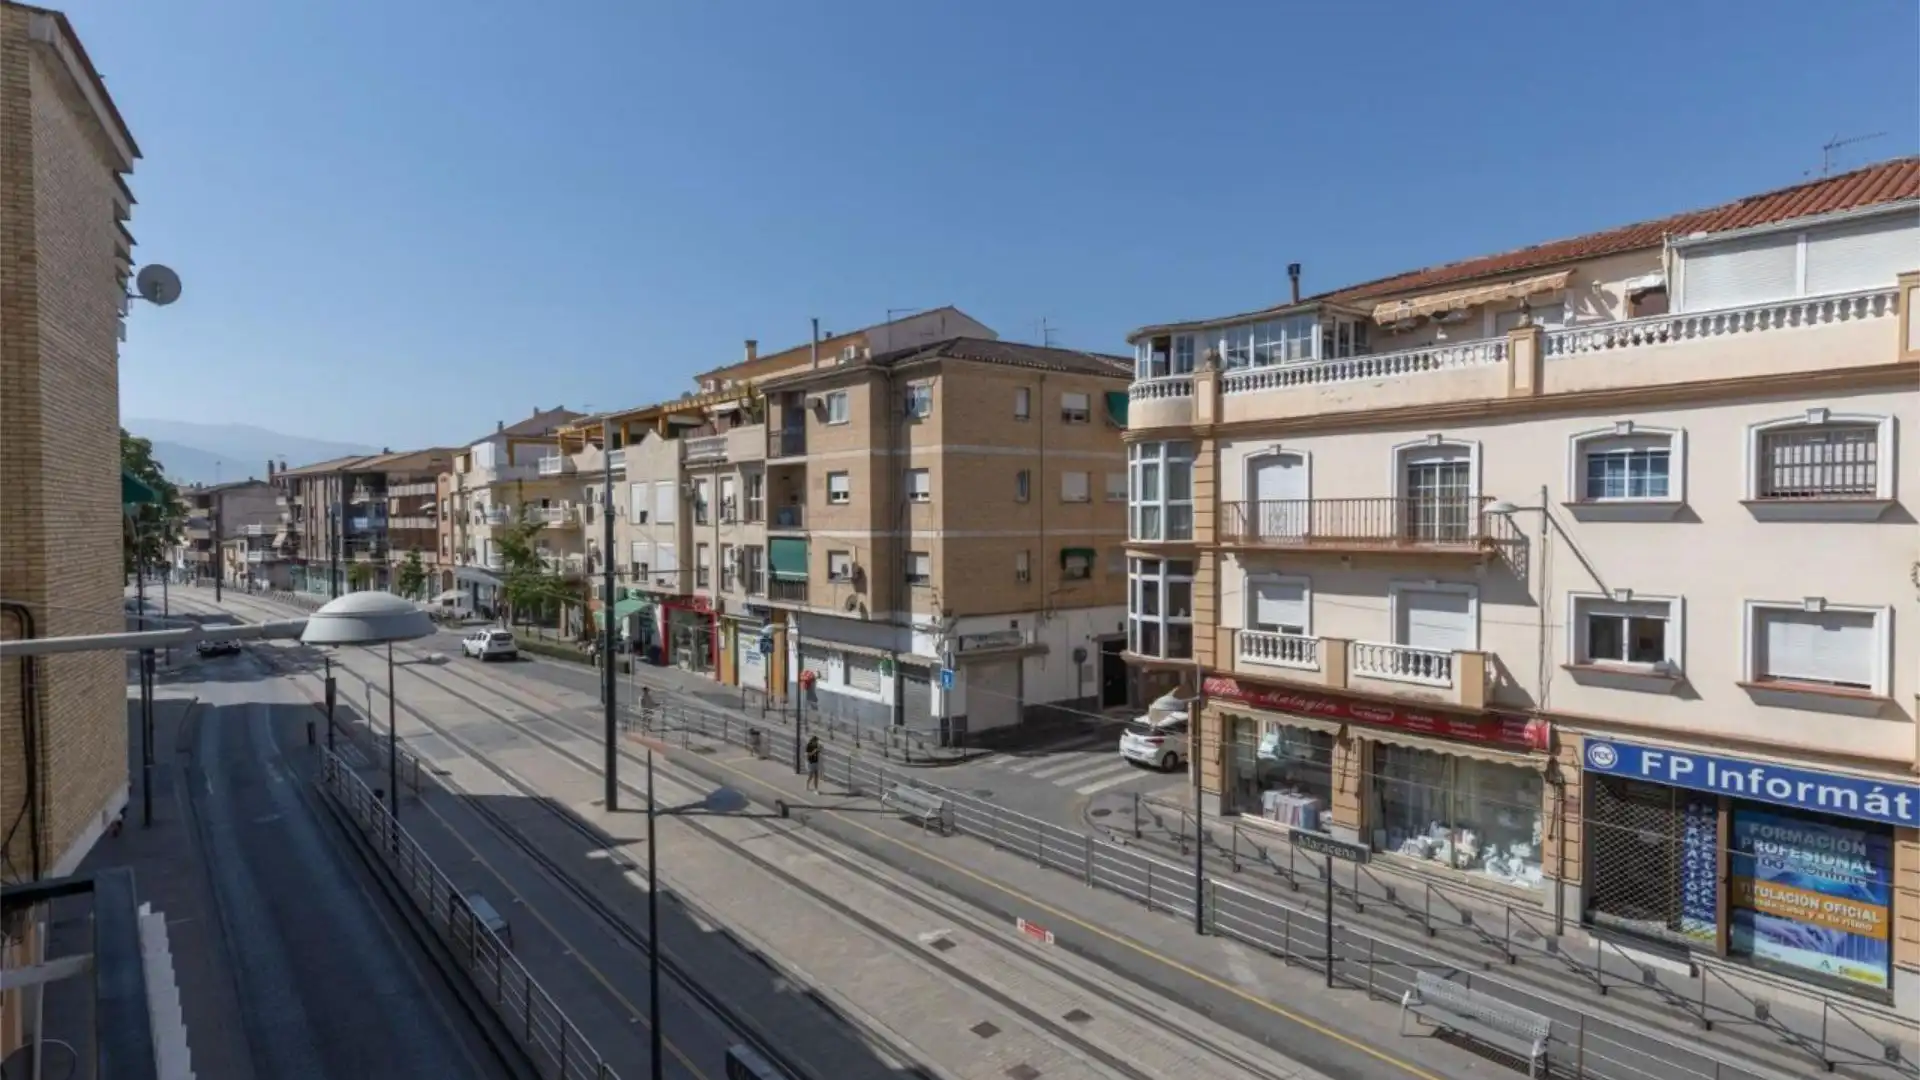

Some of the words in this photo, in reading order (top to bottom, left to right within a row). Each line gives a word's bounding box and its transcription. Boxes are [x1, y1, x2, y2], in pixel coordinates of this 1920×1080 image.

[1641, 751, 1694, 780] FP
[1707, 761, 1913, 819] Informát
[1741, 836, 1877, 875] PROFESIONAL
[1823, 902, 1881, 924] OFICIAL
